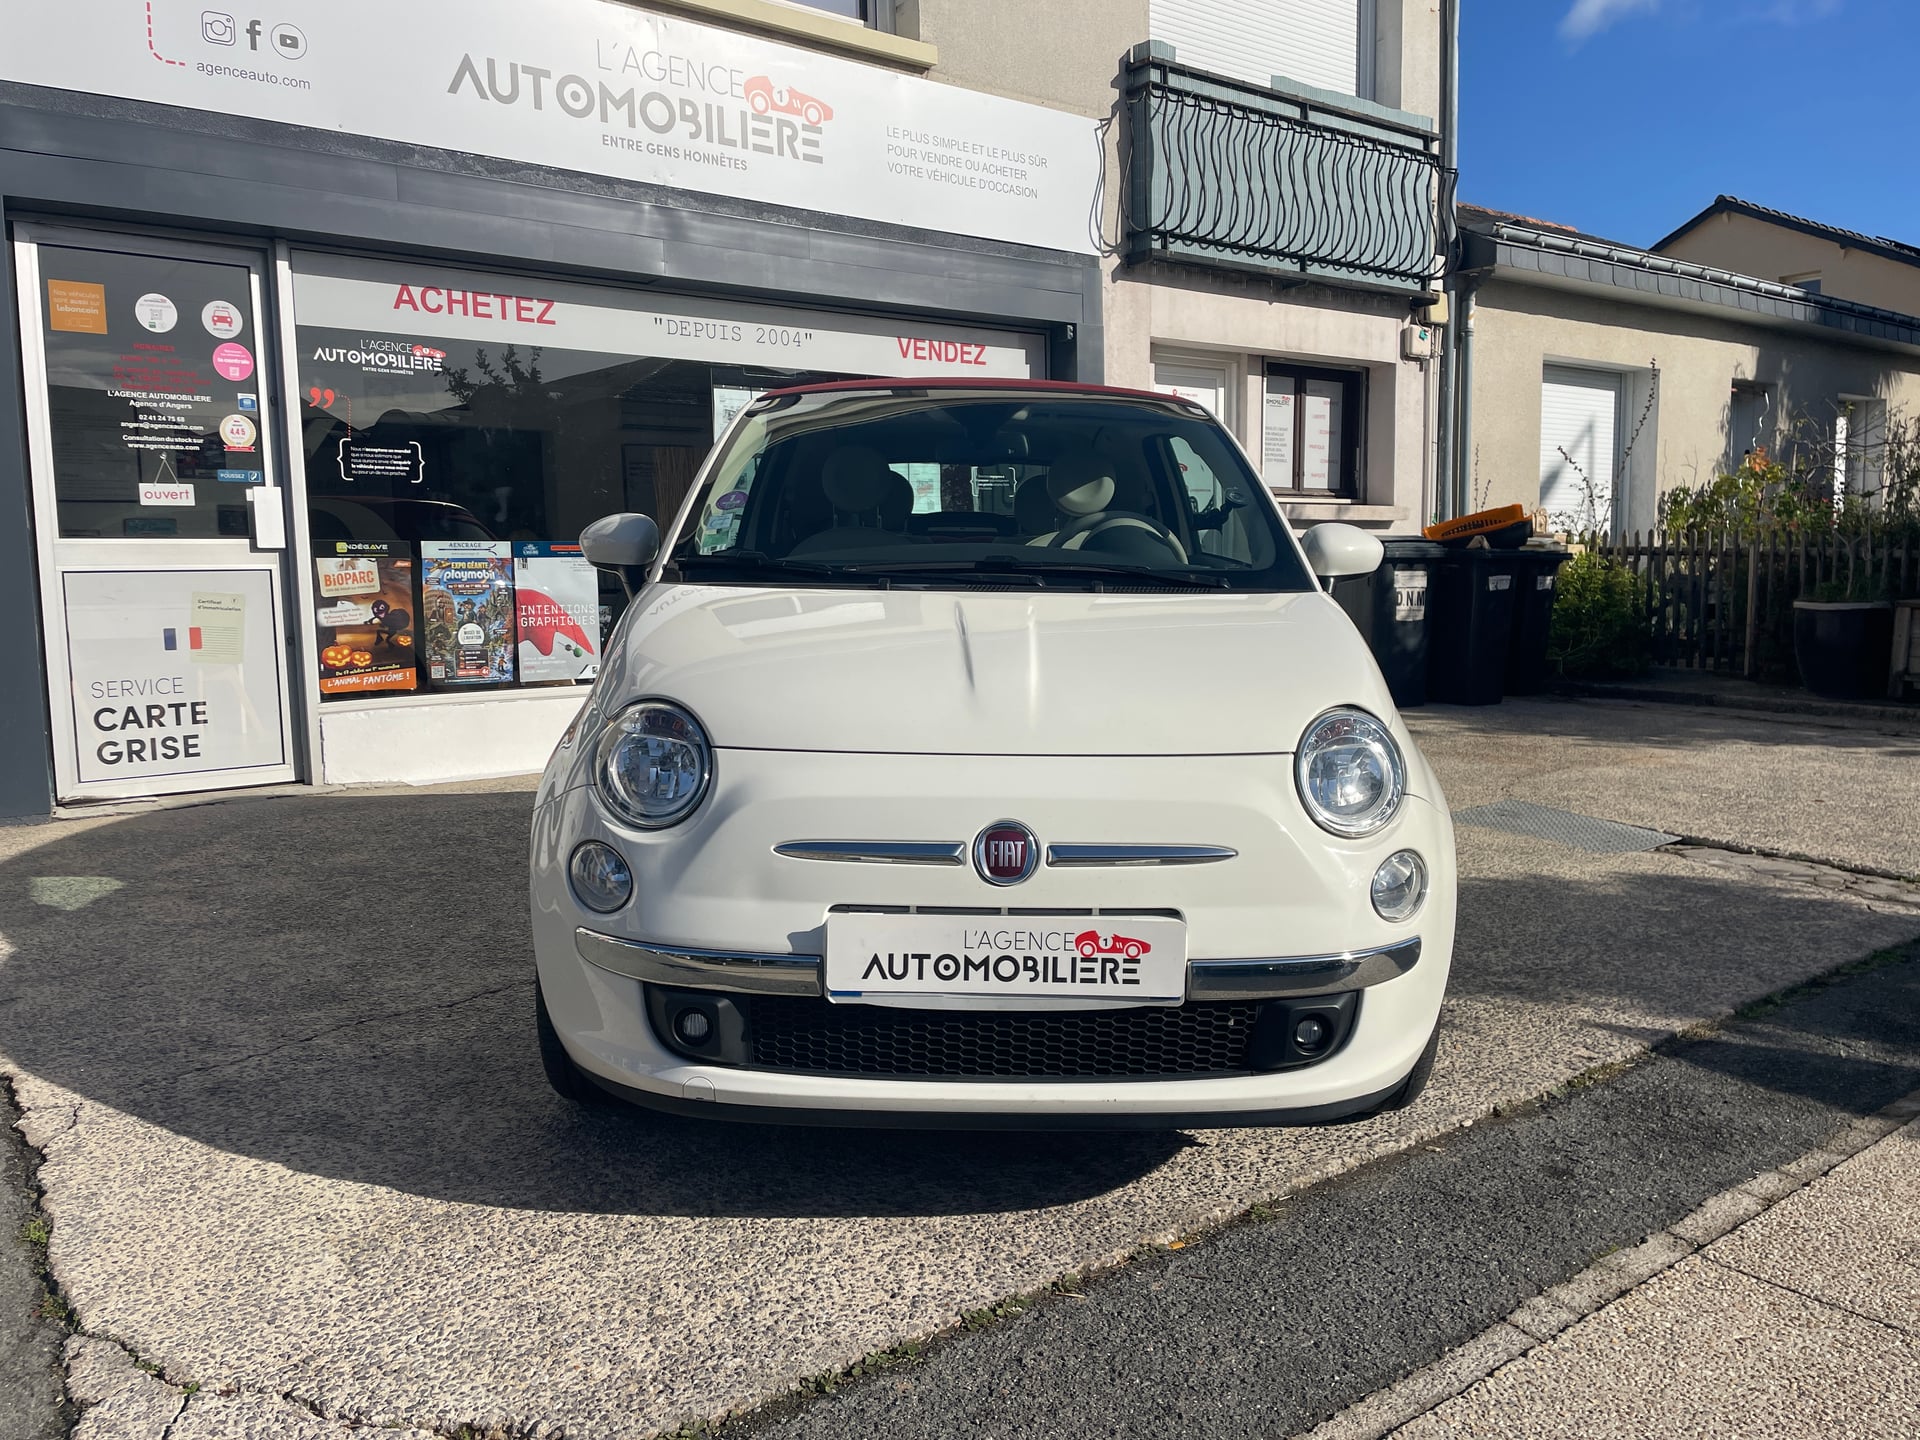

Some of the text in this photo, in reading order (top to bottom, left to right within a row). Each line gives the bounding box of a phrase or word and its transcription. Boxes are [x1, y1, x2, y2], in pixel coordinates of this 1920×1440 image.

[196, 62, 311, 90] agenceauto.com
[602, 134, 748, 171] ENTRE GENS HONNÊTES
[886, 125, 1048, 168] LE PLUS SIMPLE ET LE PLUS SÛR
[887, 143, 1027, 181] POUR VENDRE OU ACHETER
[887, 161, 1038, 199] VOTRE VÉHICULE D'OCCASION
[393, 283, 556, 326] ACHETEZ
[654, 317, 812, 347] "DEPUIS 2004"
[360, 339, 412, 354] L'AGENCE
[897, 336, 987, 366] VENDEZ
[107, 390, 212, 402] L'AGENCE AUTOMOBILIERE
[129, 399, 192, 409] Agence d'Angers
[122, 434, 165, 442] Consultation
[174, 436, 193, 444] stock
[127, 443, 200, 451] www.agenceauto.com
[144, 489, 190, 500] ouvert
[443, 569, 495, 583] playmobil
[450, 560, 489, 569] EXPO GÉANTE
[520, 604, 595, 615] INTENTIONS
[520, 615, 596, 628] GRAPHIQUES
[91, 676, 185, 699] SERVICE
[327, 678, 361, 688] L'ANIMAL
[362, 671, 404, 686] FANTÔME
[93, 701, 209, 732] CARTE
[96, 733, 201, 765] GRISE
[989, 840, 1025, 868] FIAT
[963, 929, 1076, 952] L'AGENCE
